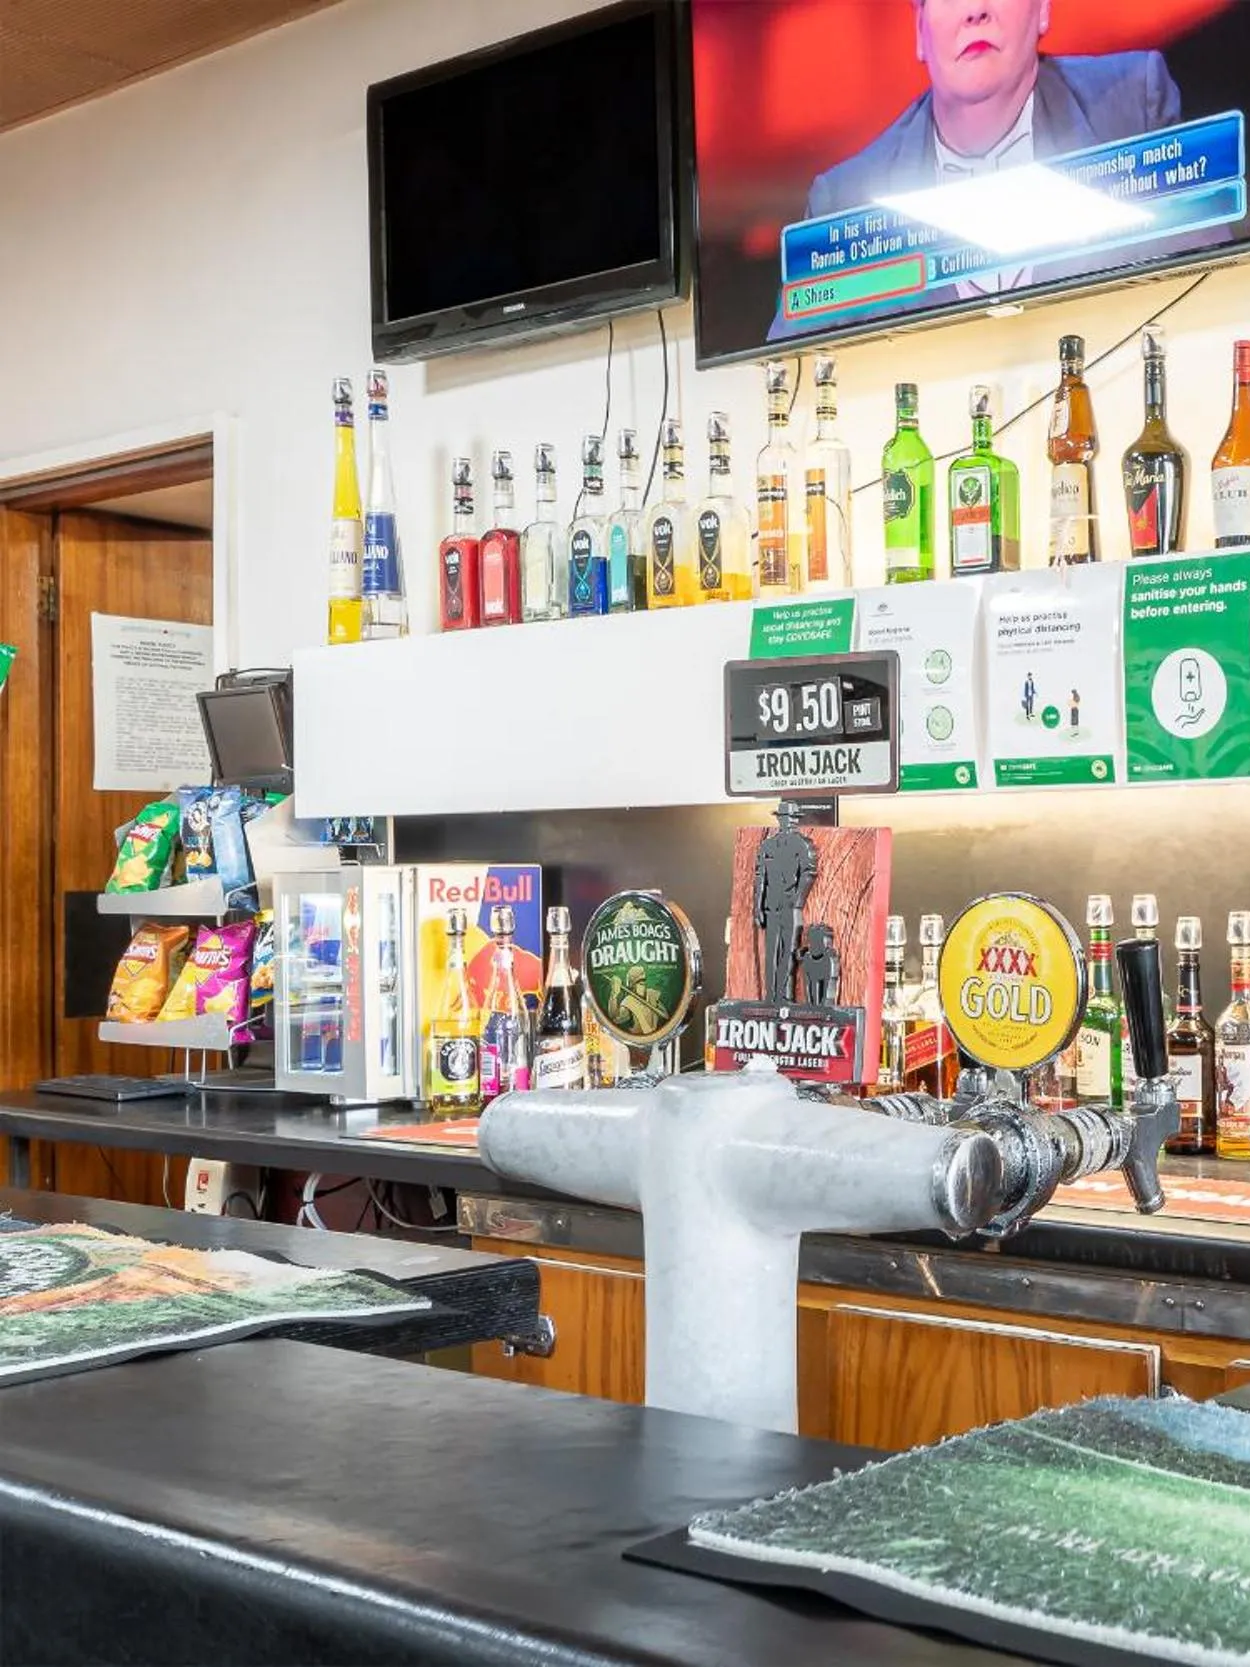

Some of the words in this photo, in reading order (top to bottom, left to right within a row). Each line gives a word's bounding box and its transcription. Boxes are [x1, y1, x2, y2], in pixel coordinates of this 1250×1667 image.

[1143, 138, 1183, 163] match
[1165, 157, 1207, 185] what?
[829, 225, 840, 244] In
[845, 222, 860, 240] his
[865, 214, 888, 236] first
[811, 248, 846, 271] Ronnie
[850, 236, 903, 261] O'Sullivan
[654, 524, 673, 537] vok
[700, 515, 719, 530] vok
[1131, 587, 1178, 603] sanitise
[1178, 585, 1208, 600] your
[1210, 579, 1248, 594] hands
[1133, 571, 1170, 586] Please
[1172, 567, 1213, 583] always
[1130, 604, 1170, 620] before
[1172, 599, 1228, 616] entering.
[758, 682, 839, 733] $9.50
[756, 751, 806, 778] IRON
[810, 748, 862, 775] JACK
[429, 877, 480, 904] Red
[483, 874, 532, 903] Bull
[596, 923, 631, 948] JAMES
[632, 922, 672, 940] BOAG'S
[591, 939, 680, 969] DRAUGHT
[977, 946, 1038, 977] XXXX
[959, 976, 1053, 1027] GOLD
[716, 1018, 777, 1051] IRON
[777, 1021, 840, 1057] JACK
